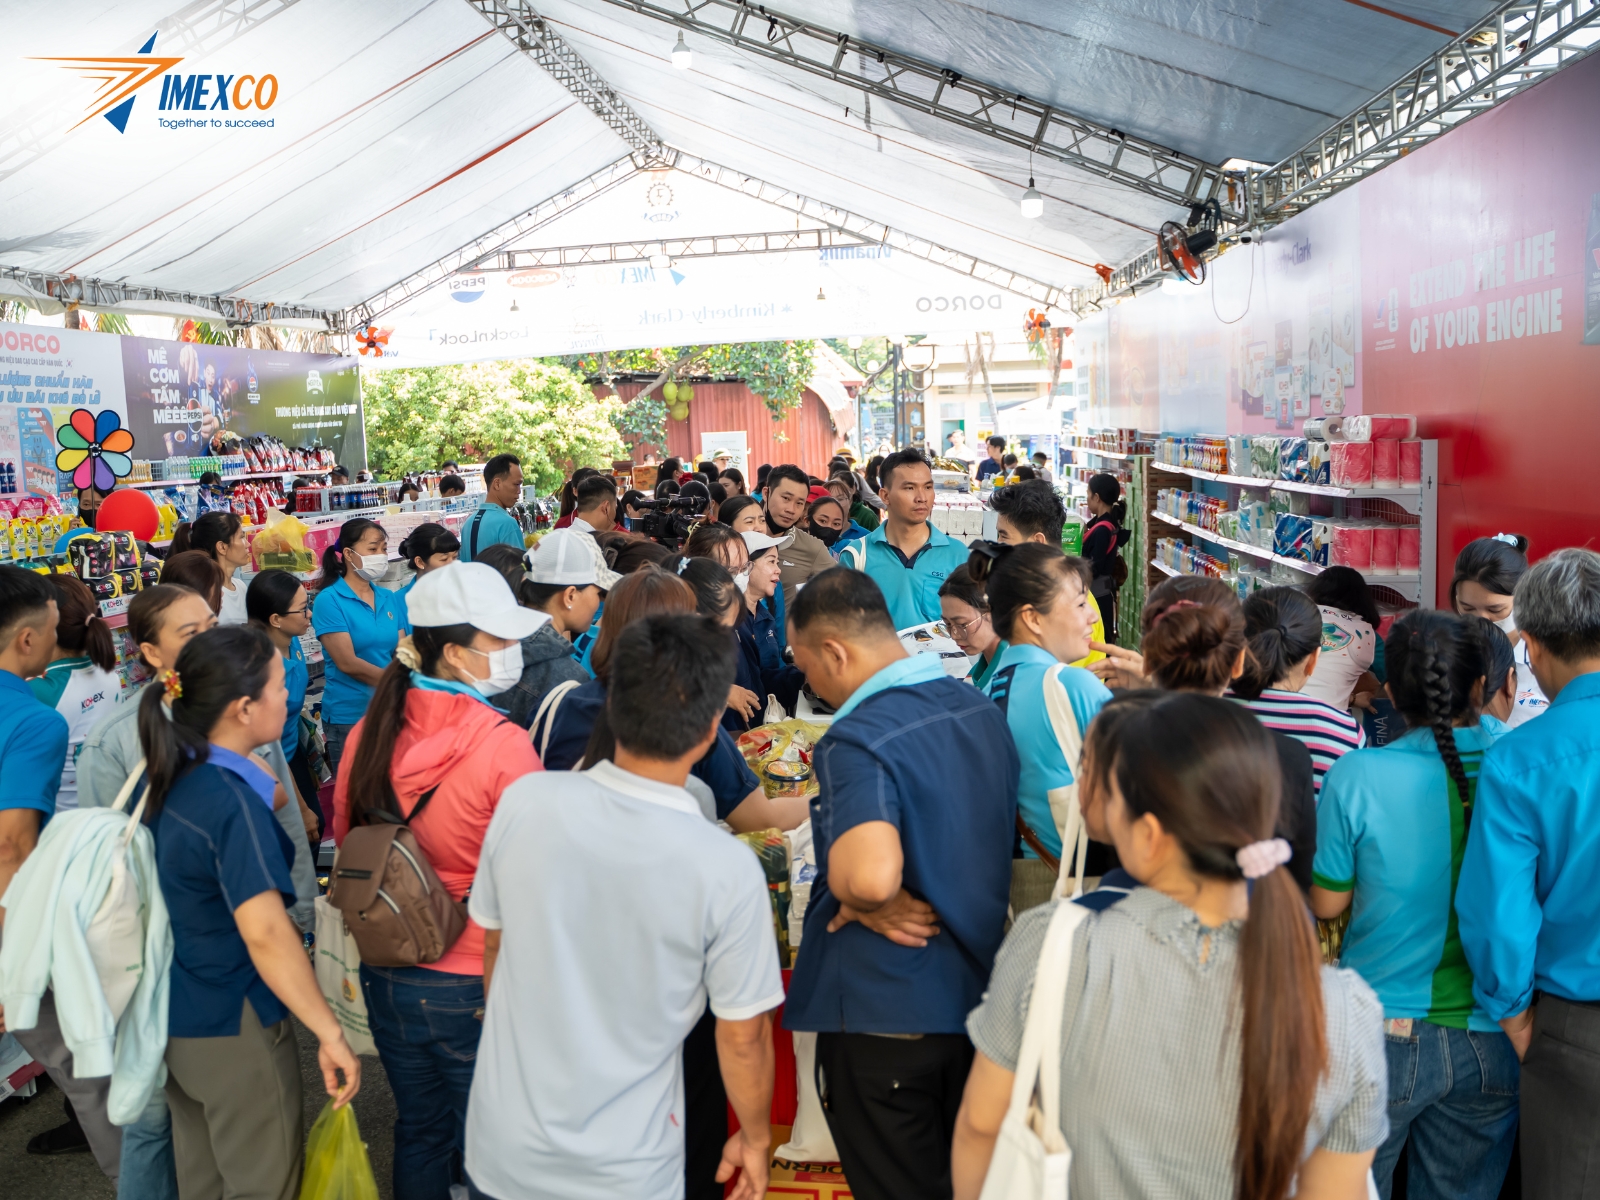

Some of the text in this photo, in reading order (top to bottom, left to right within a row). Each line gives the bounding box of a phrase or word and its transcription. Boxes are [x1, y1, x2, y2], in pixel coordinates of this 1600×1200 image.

[1409, 229, 1556, 309] EXTEND THE LIFE
[1409, 315, 1429, 354] OF
[1433, 304, 1480, 350] YOUR
[1486, 286, 1563, 343] ENGINE
[0, 331, 60, 354] ORCO
[147, 346, 168, 365] MÊ
[149, 367, 180, 384] CƠM
[151, 384, 181, 404] TẤM
